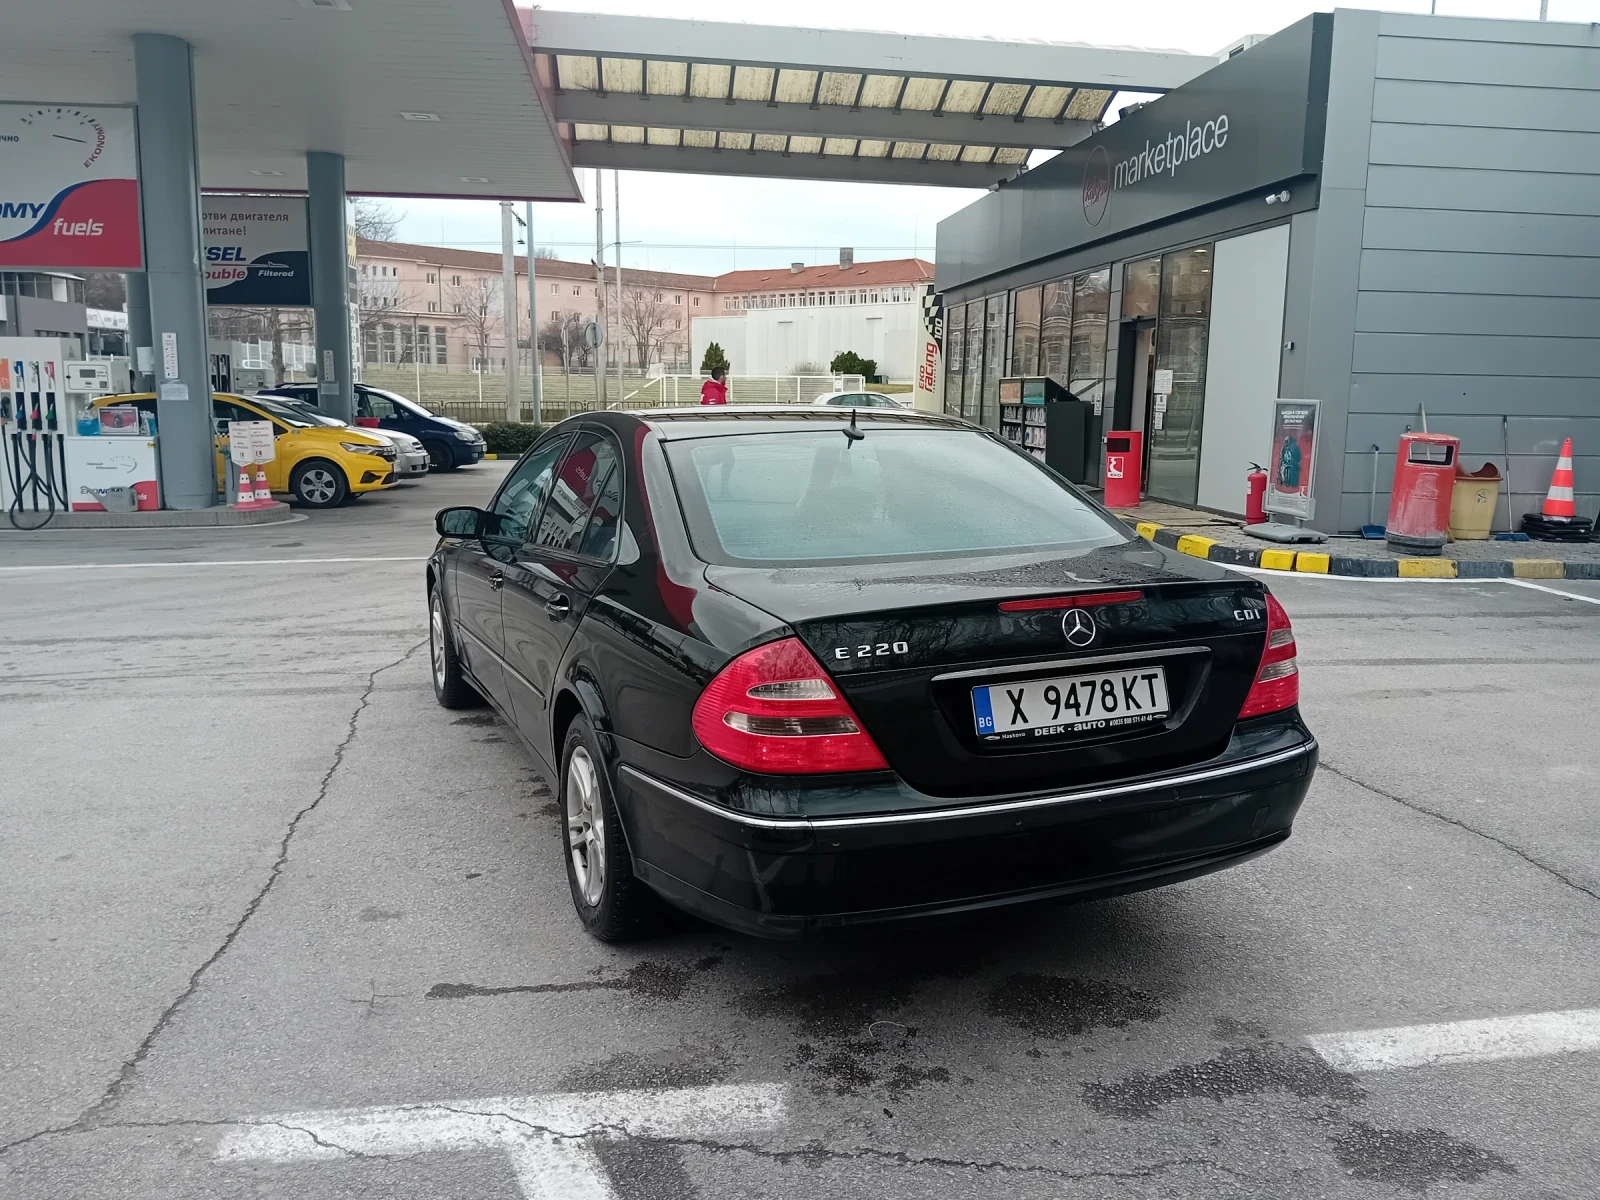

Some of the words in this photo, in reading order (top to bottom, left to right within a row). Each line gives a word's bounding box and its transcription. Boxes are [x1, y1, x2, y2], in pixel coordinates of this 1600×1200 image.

[83, 123, 106, 168] EKONOMY
[1113, 114, 1229, 191] marketplace
[53, 217, 104, 236] fuels
[230, 213, 289, 223] двигателя
[258, 269, 295, 278] Filtered
[934, 317, 943, 340] 100
[924, 341, 938, 393] racing
[918, 364, 926, 391] EKO
[1233, 608, 1260, 621] CDI
[834, 646, 851, 660] E
[857, 641, 909, 658] 220
[1006, 688, 1029, 725] X
[978, 717, 993, 728] BG
[1034, 725, 1065, 737] DEEK
[1001, 732, 1026, 740] Haskovo
